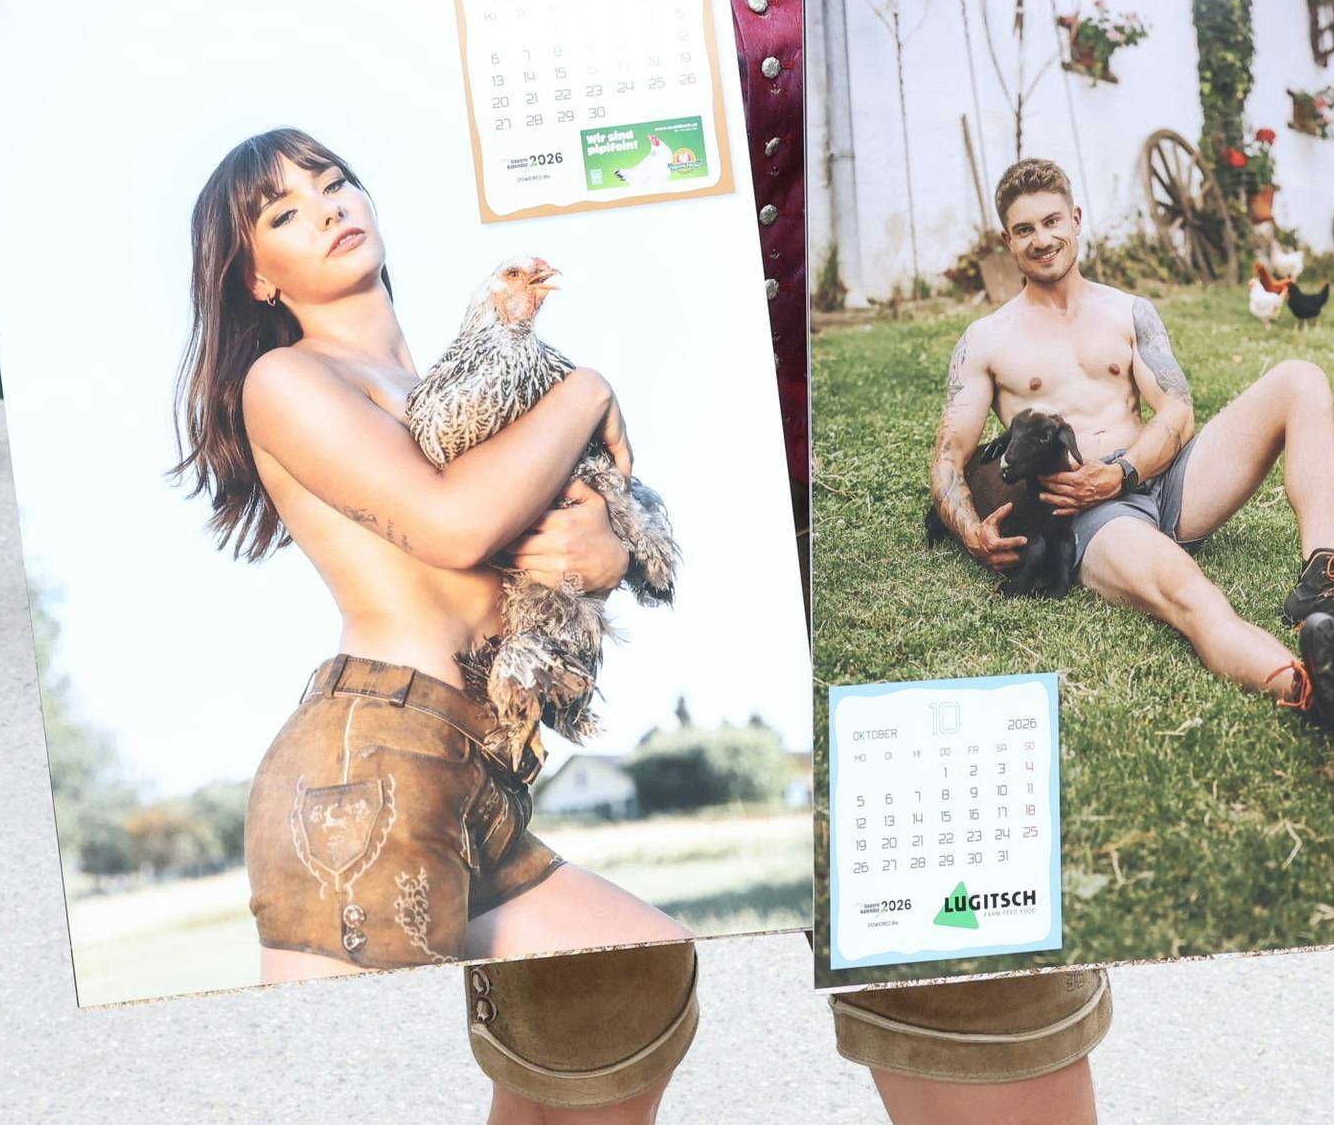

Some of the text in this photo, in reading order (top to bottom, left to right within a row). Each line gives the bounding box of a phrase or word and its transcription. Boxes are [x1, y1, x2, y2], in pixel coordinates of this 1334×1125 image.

[491, 53, 499, 65] 6
[523, 50, 531, 59] 7
[492, 75, 504, 86] 13
[523, 72, 535, 82] 14
[555, 67, 567, 79] 15
[492, 73, 696, 109] 20 21 22 23 24 25 26
[495, 107, 605, 130] 27 28 29 30
[586, 129, 634, 144] Wir sind
[529, 152, 563, 167] 2026
[853, 718, 1037, 741] OKTOBER 2026
[930, 702, 961, 736] 10
[944, 761, 1033, 778] 1 2 3 4
[857, 783, 1033, 807] 5 6 7 8 9 10 11
[856, 805, 1035, 829] 12 13 14 15 16 17 18
[856, 826, 1038, 851] 19 20 21 22 23 24 25
[853, 850, 1008, 873] 26 27 28 29 30 31
[881, 899, 912, 913] 2026
[944, 890, 1036, 913] LUGITSCH
